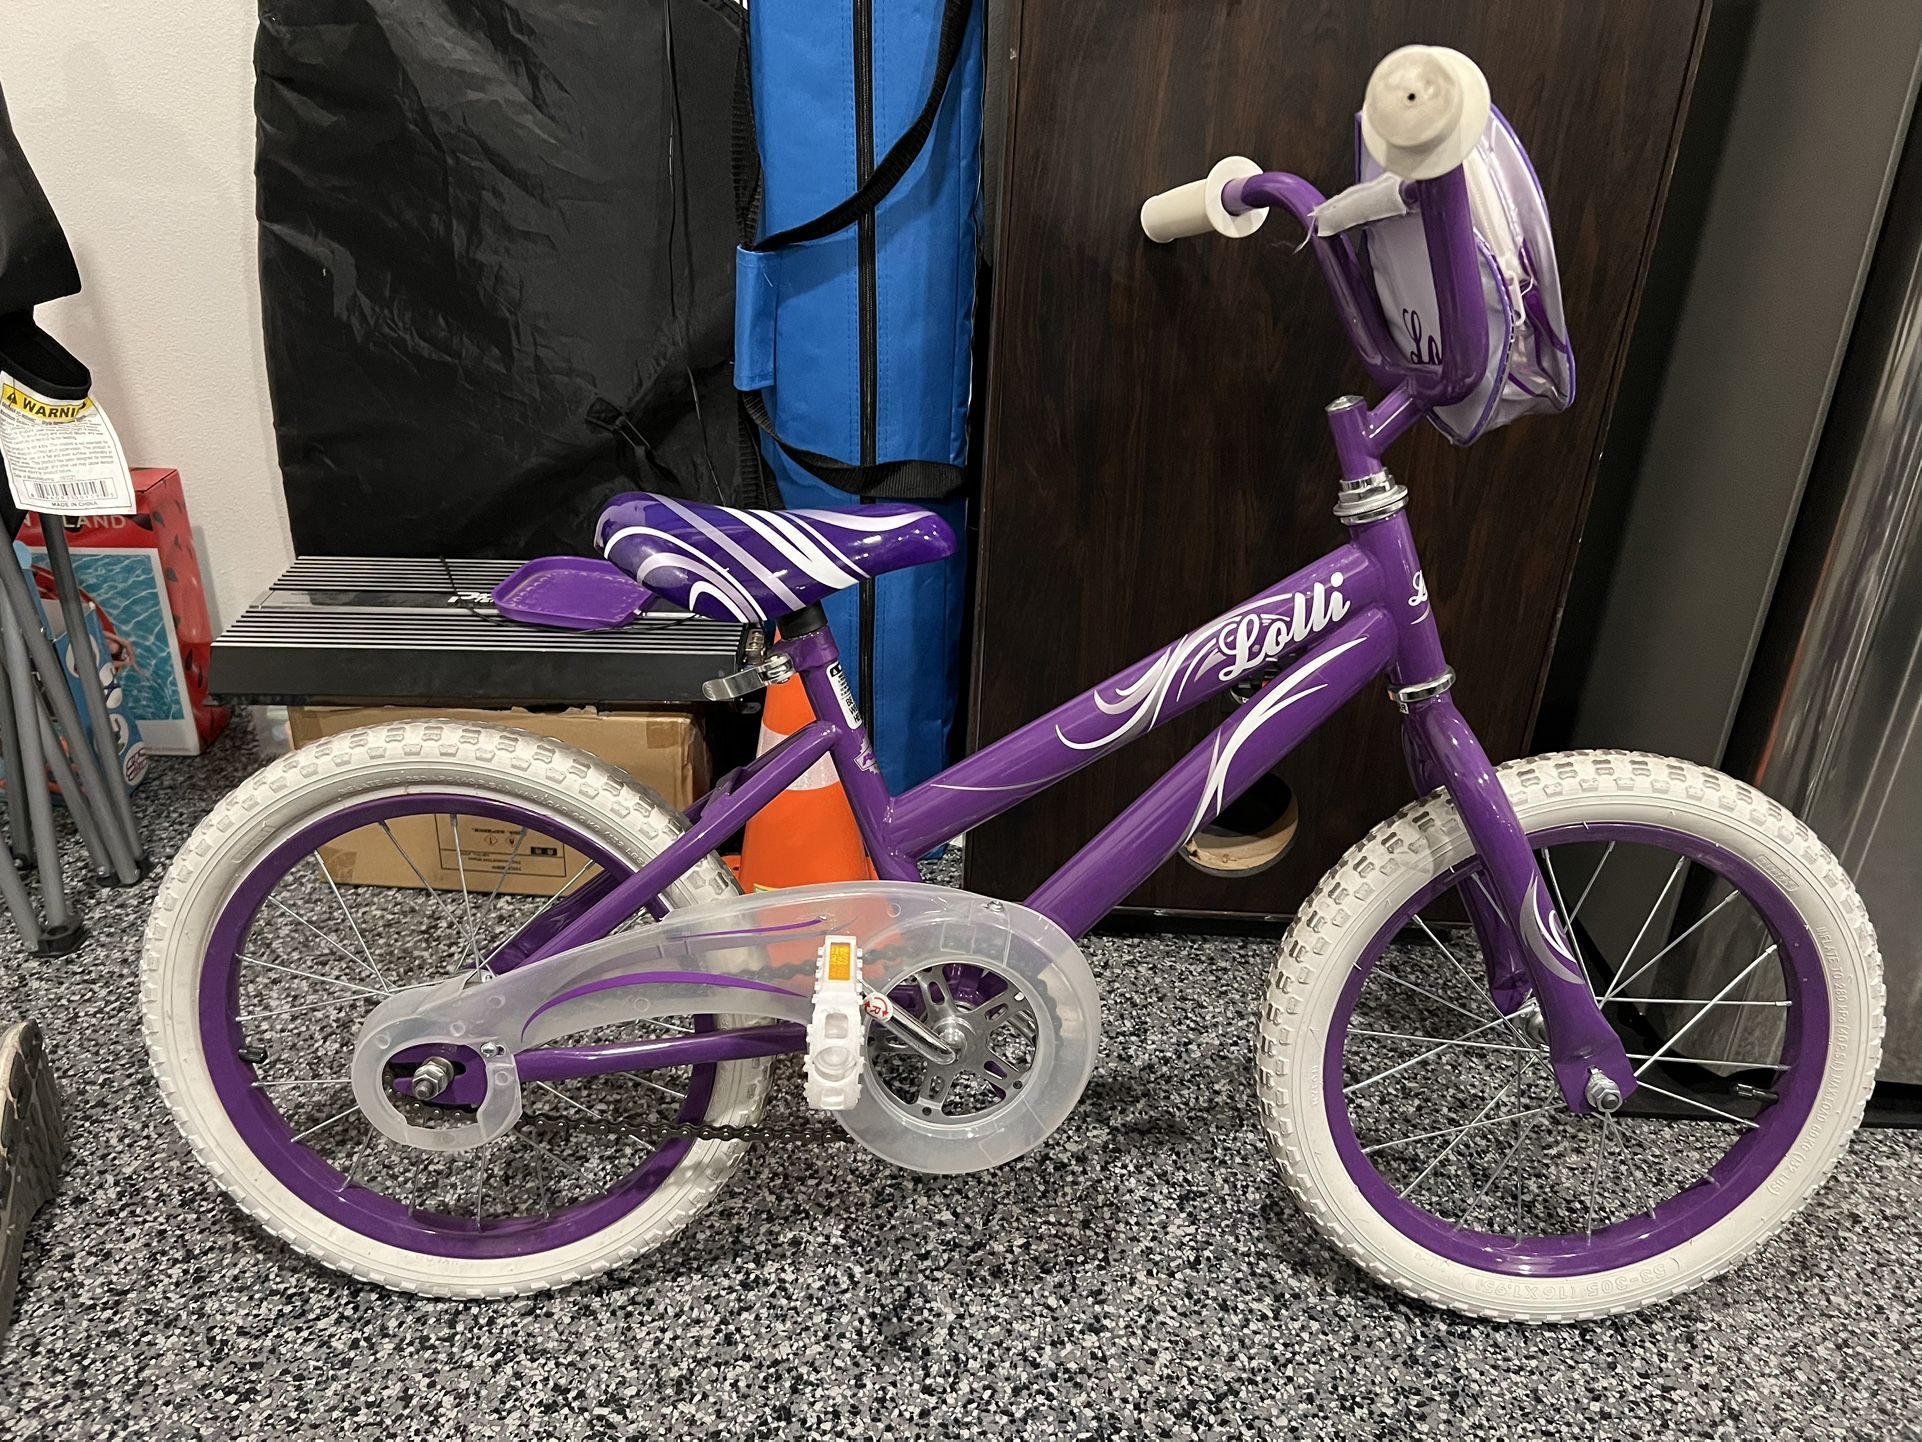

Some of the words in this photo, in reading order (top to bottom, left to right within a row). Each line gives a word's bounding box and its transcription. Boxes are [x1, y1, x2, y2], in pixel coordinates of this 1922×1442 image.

[23, 397, 86, 418] WARNI
[1218, 572, 1351, 681] Lolli
[870, 1004, 881, 1015] R
[1586, 1264, 1667, 1296] 53-305
